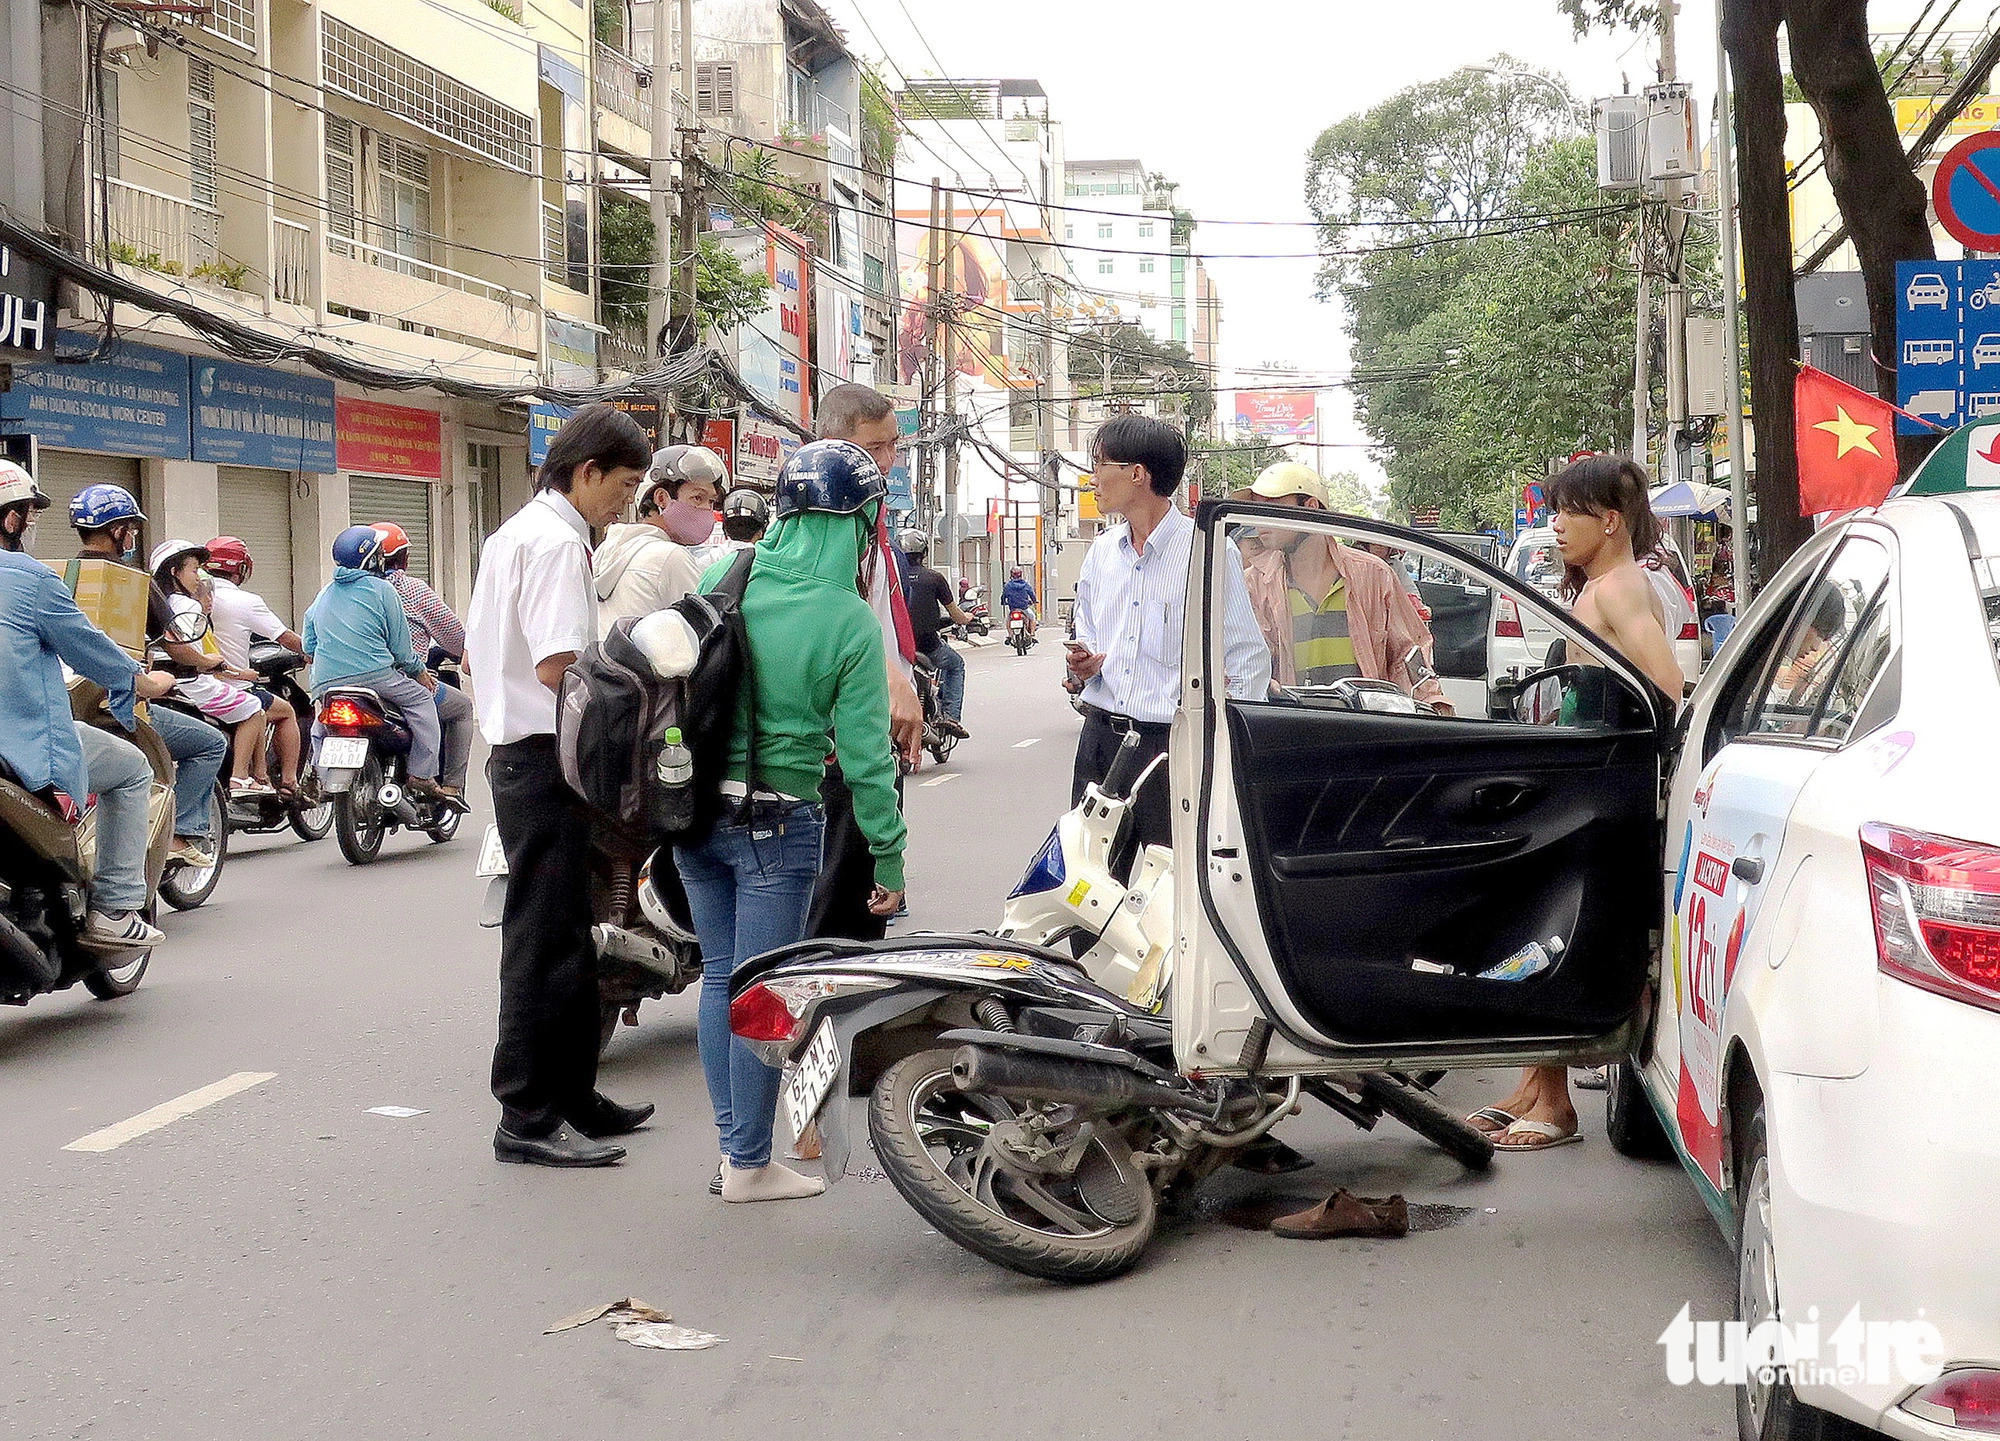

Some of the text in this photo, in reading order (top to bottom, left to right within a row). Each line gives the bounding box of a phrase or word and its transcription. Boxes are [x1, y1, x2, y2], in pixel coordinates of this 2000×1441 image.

[787, 471, 820, 481] YAMAHA
[877, 952, 968, 966] Galaxy
[971, 953, 1033, 972] SR
[792, 1034, 825, 1102] 62-N1
